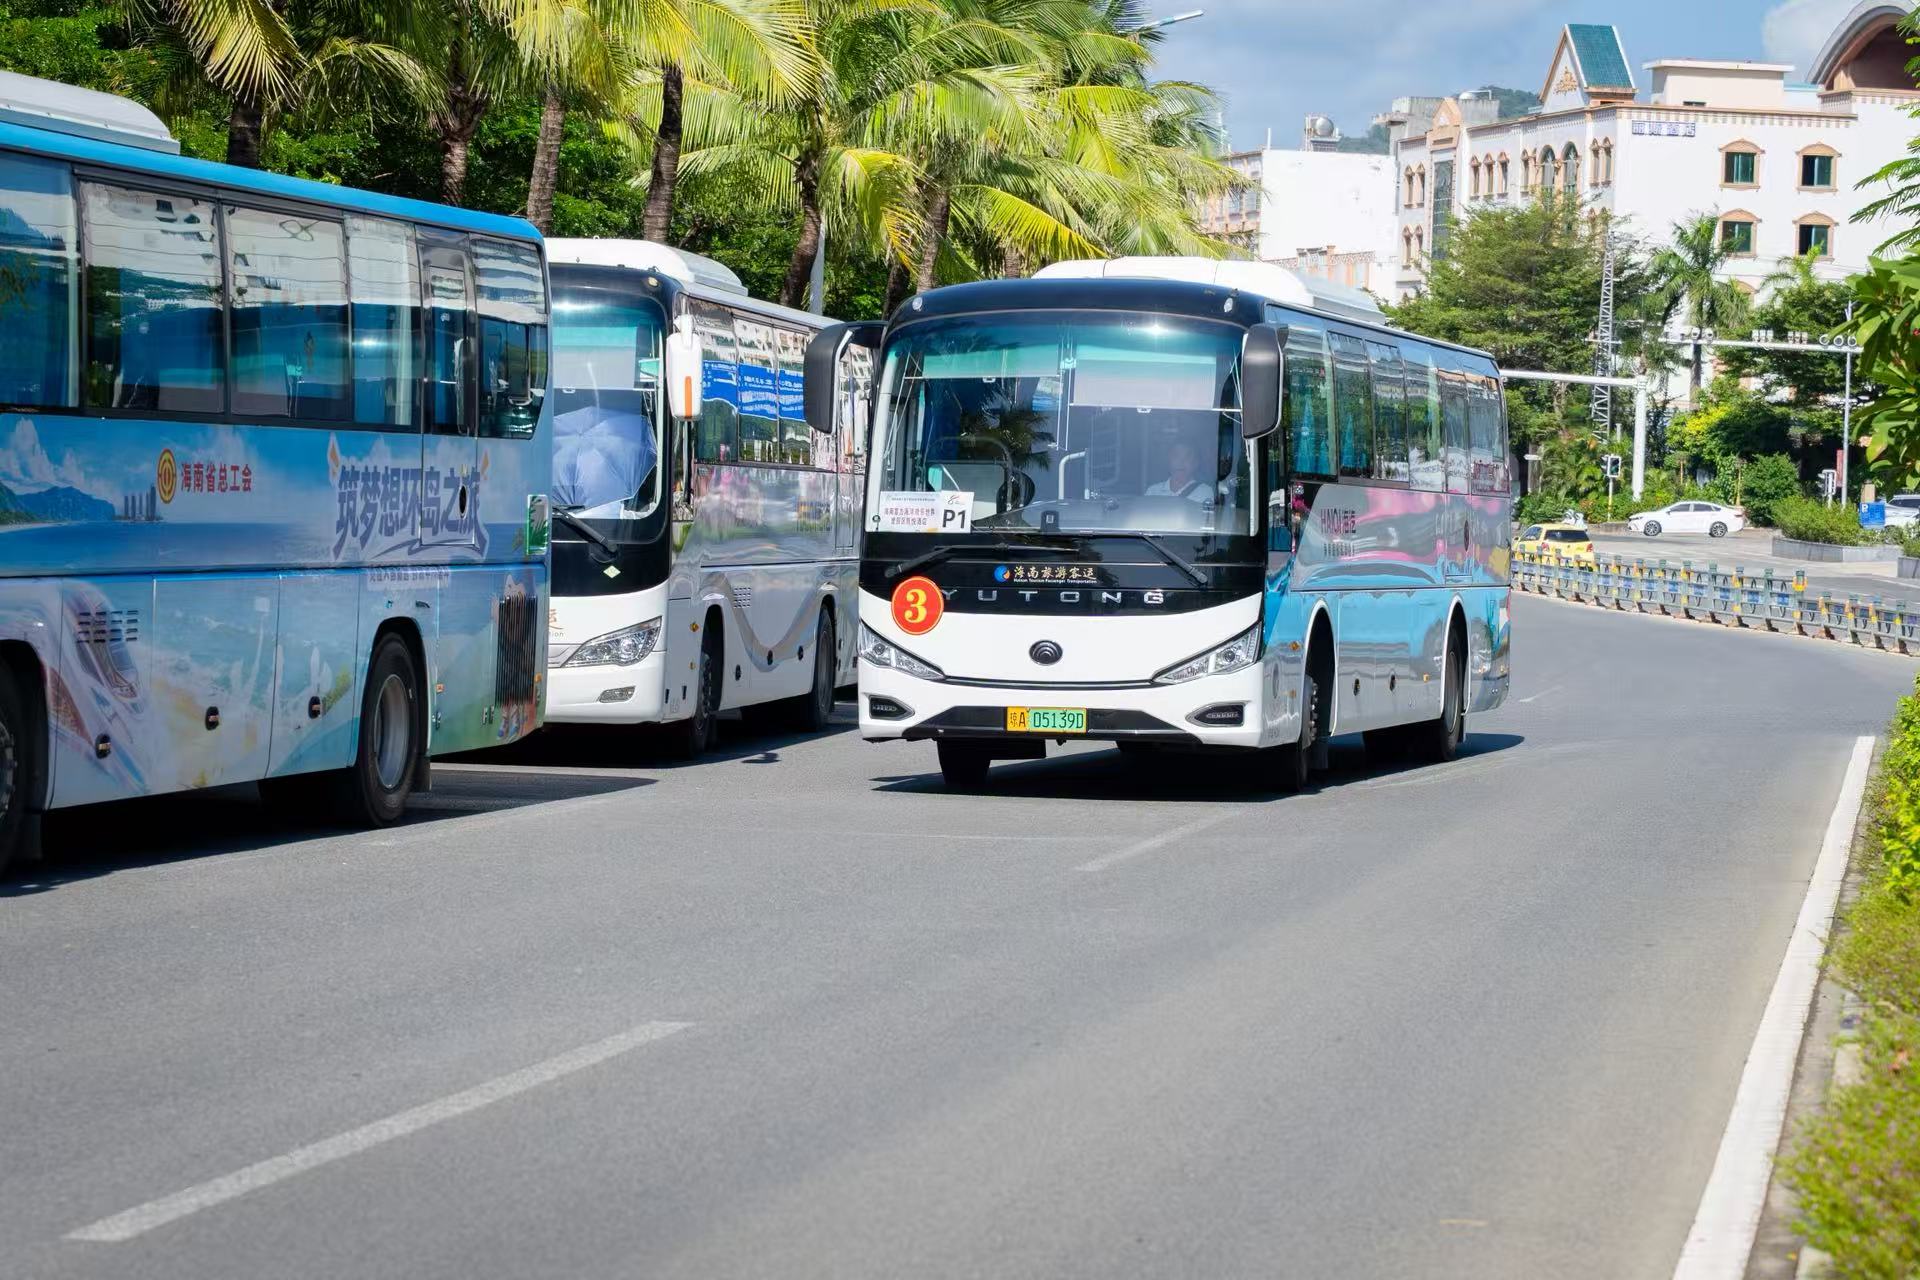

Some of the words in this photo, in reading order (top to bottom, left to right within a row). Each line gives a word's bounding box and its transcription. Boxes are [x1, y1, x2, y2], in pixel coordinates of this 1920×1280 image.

[181, 461, 252, 493] 海南省总工会
[333, 465, 487, 560] 筑梦想环岛之旅
[942, 509, 966, 529] P1
[1014, 566, 1096, 579] 海南旅游客运
[904, 588, 928, 623] 3
[941, 589, 1164, 605] YUTONG
[1033, 712, 1084, 729] 05139D
